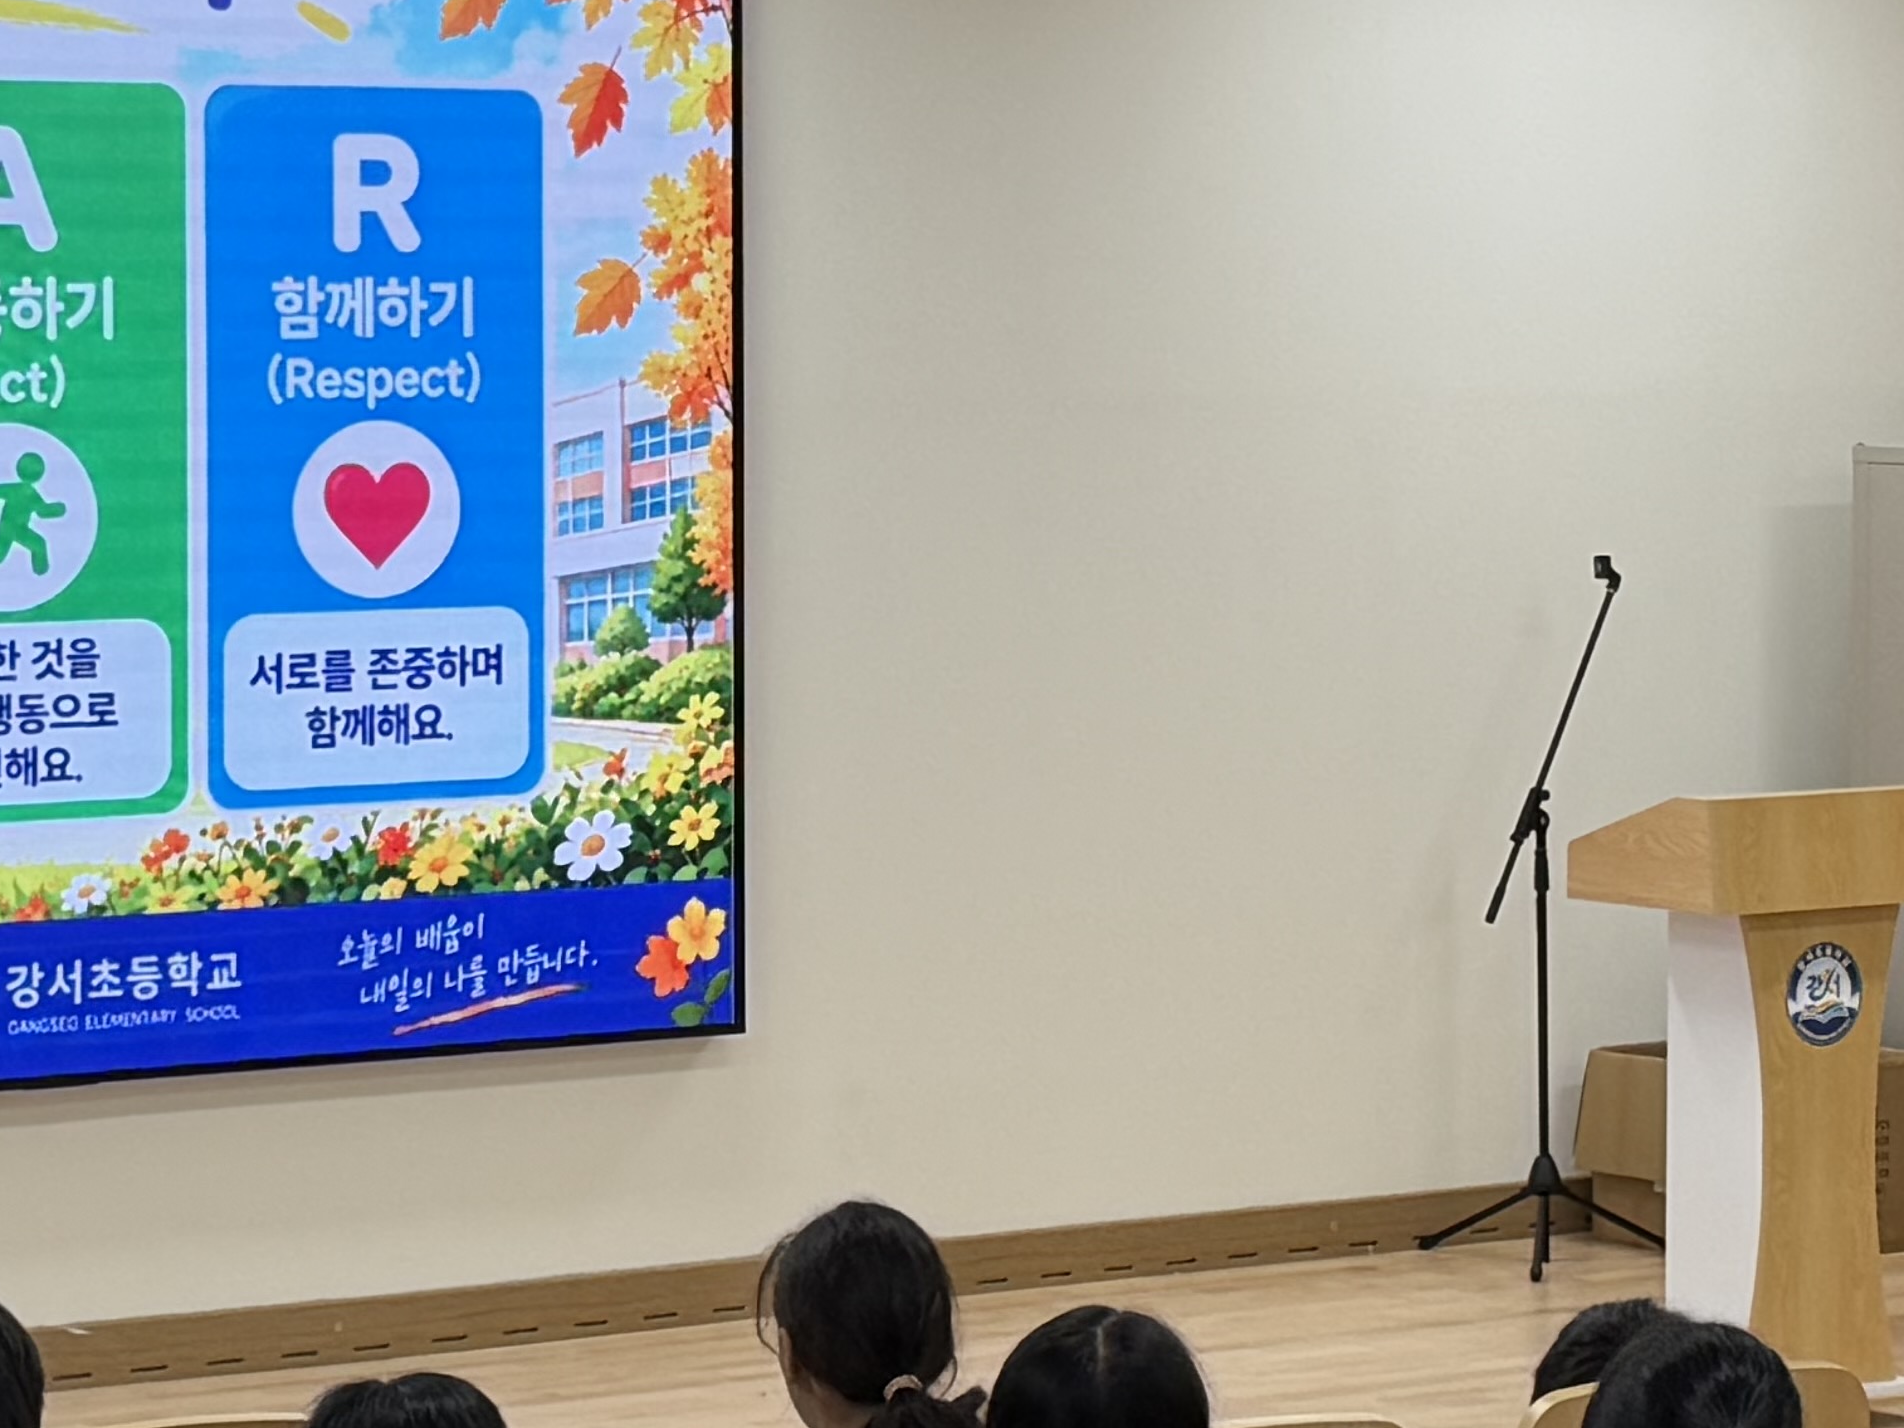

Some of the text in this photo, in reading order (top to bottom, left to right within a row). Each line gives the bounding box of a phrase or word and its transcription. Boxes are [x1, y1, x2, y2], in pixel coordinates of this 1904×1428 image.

[332, 133, 422, 253] R
[271, 275, 474, 340] 함께하기
[267, 355, 481, 407] (Respect)
[31, 637, 101, 681] 것을
[249, 643, 503, 695] 서로를 존중하며
[305, 702, 454, 750] 함께해요.
[336, 912, 485, 971] 오늘의 배움이
[5, 950, 243, 1010] 강서초등학교
[358, 938, 599, 1014] 내일의 나를 만듭니다.
